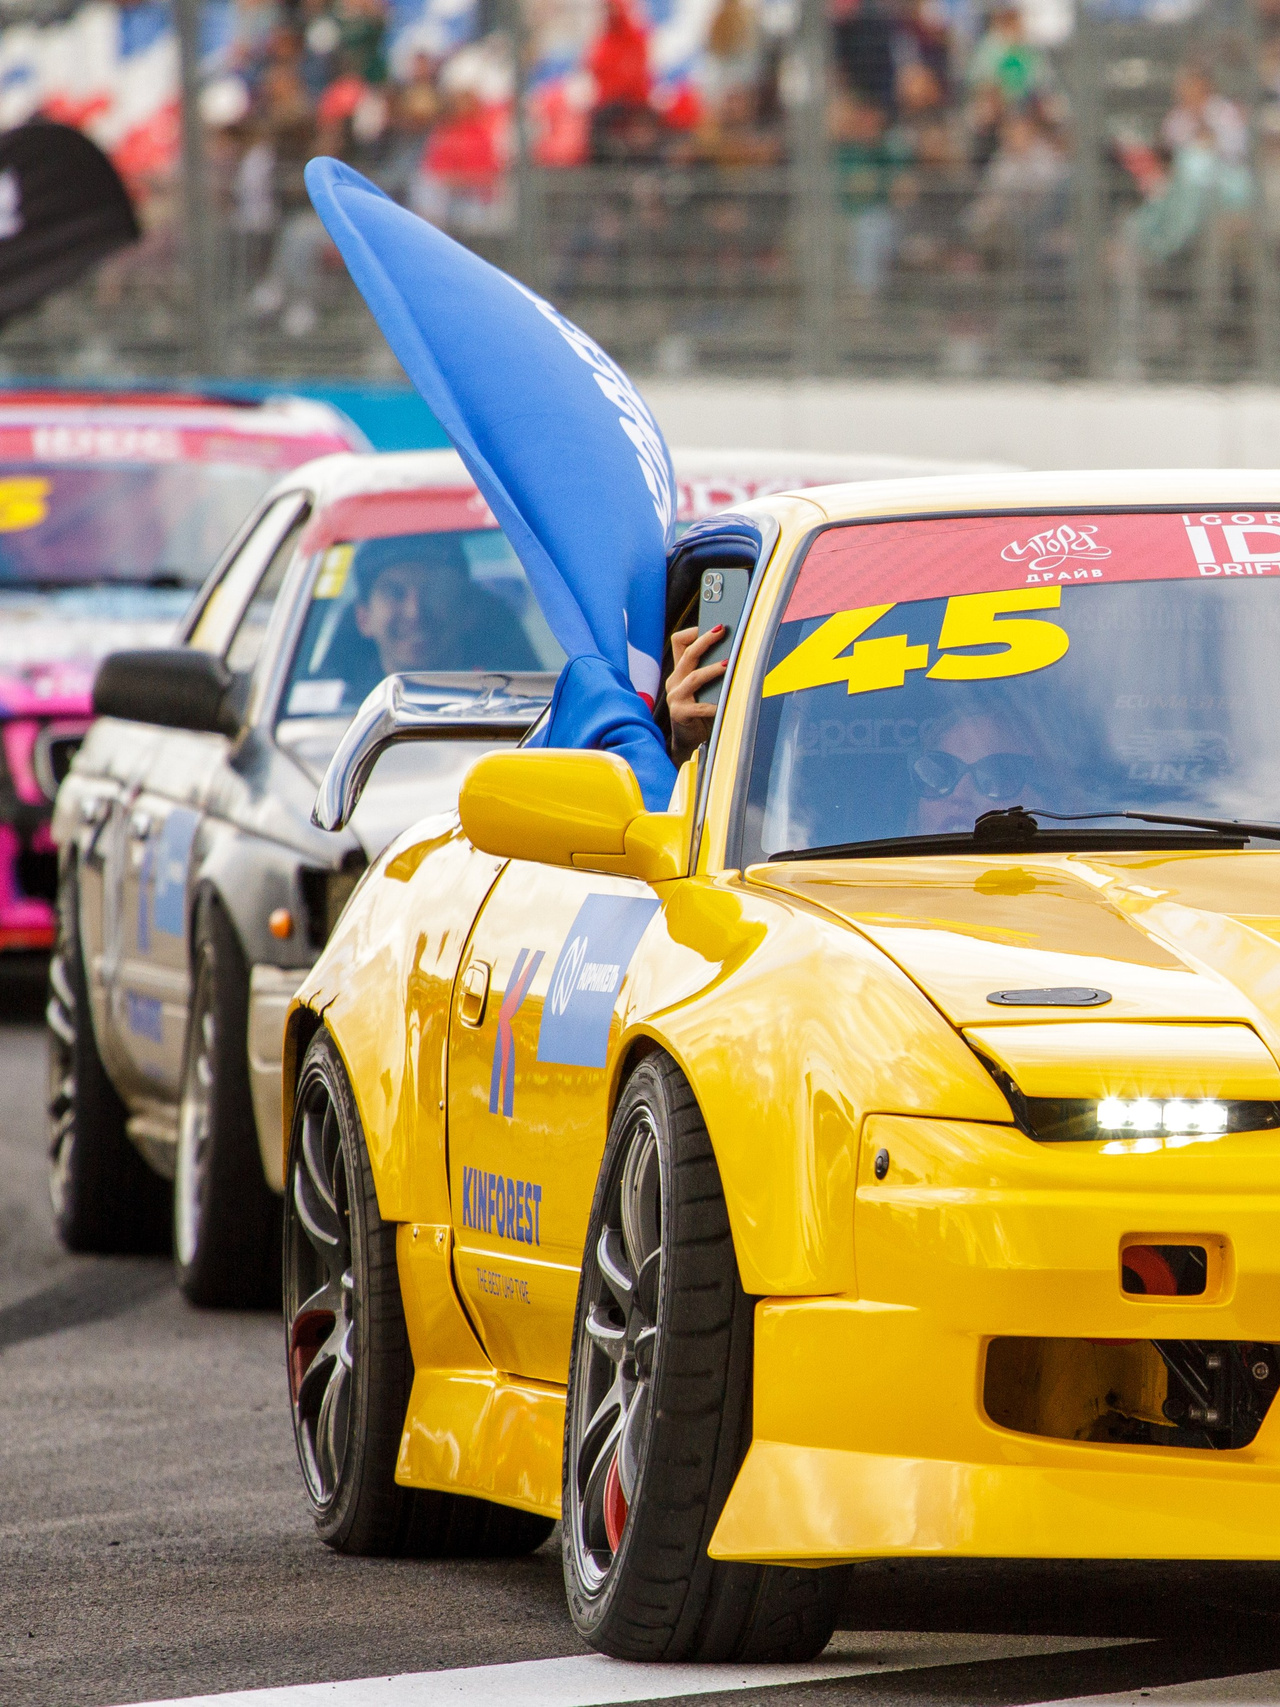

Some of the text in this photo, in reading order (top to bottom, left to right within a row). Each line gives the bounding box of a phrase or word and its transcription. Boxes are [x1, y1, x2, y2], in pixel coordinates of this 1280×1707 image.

[1025, 568, 1104, 583] ДРАЙВ
[761, 585, 1070, 698] 45
[462, 1165, 542, 1246] KINFOREST
